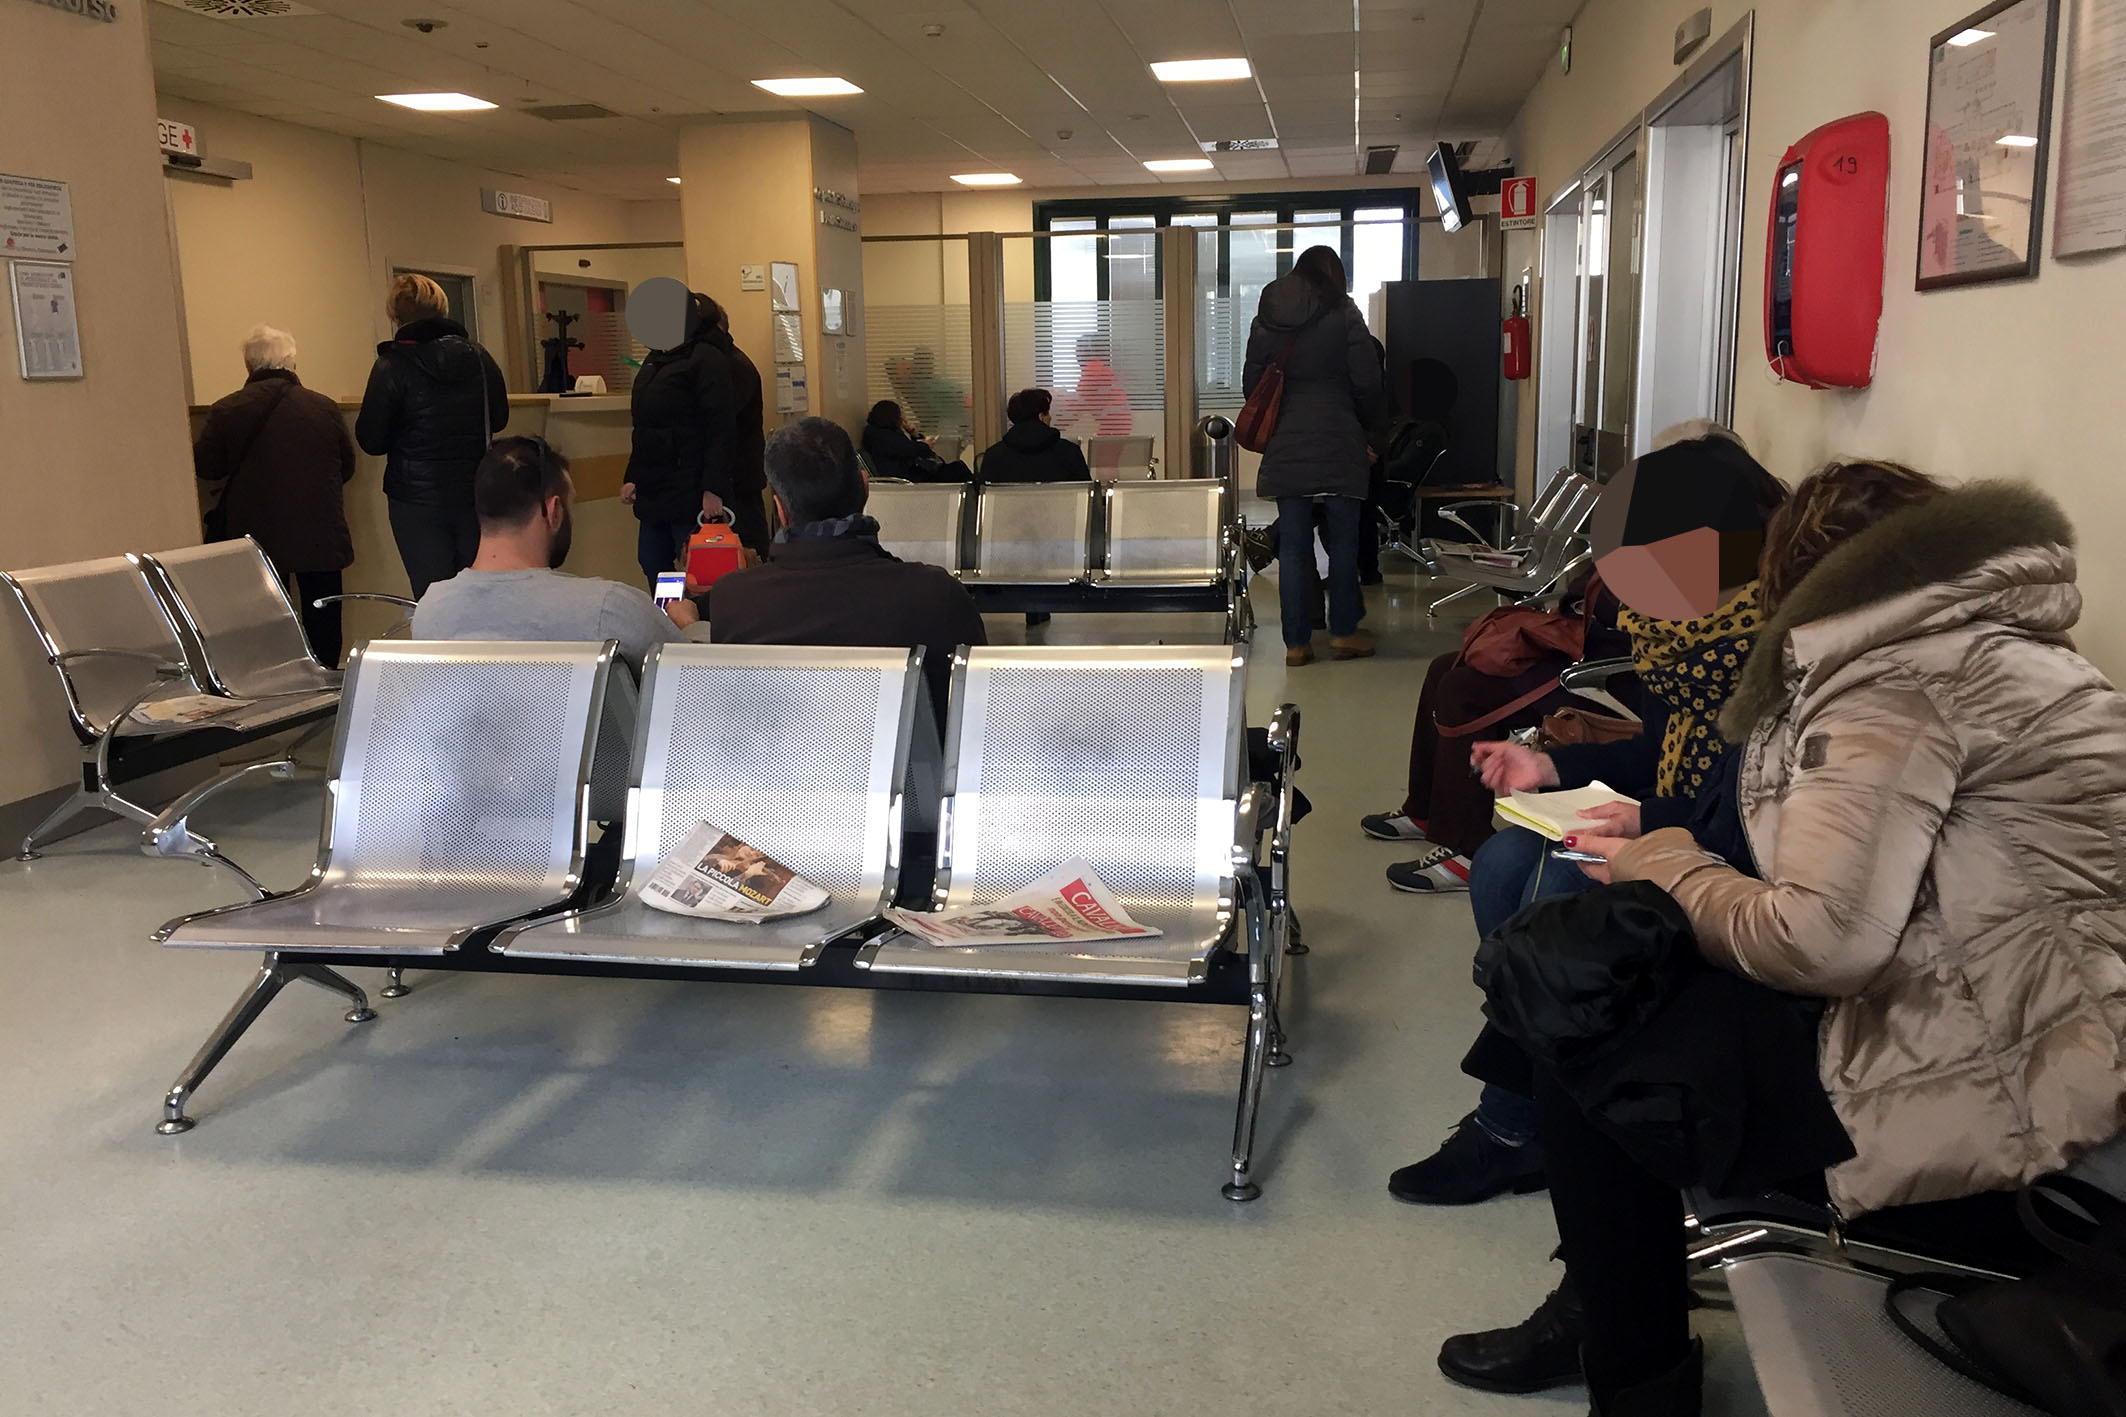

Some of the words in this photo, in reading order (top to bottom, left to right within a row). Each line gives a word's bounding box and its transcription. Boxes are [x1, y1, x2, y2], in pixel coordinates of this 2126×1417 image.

[158, 122, 178, 147] GE
[1832, 156, 1858, 174] 19
[697, 862, 709, 874] LA
[707, 867, 740, 890] PICCOLA
[738, 883, 773, 905] MOZART
